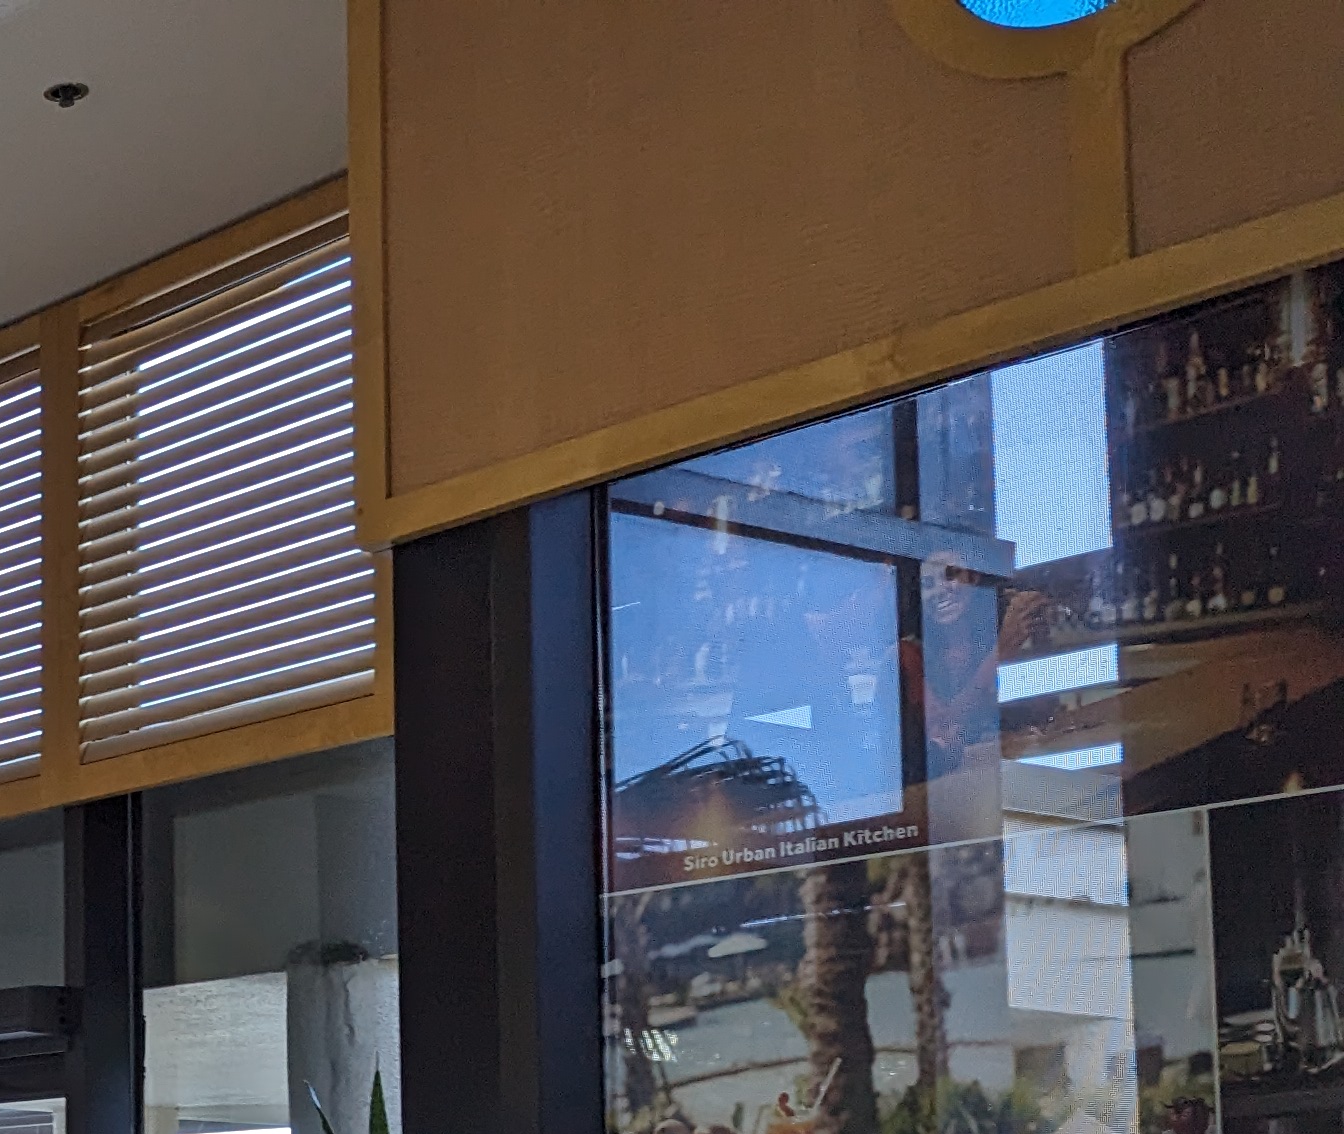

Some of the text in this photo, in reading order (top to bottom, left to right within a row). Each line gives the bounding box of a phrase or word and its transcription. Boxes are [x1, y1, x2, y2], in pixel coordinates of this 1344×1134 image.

[683, 824, 919, 872] Siro Urban Italian Kitchen
